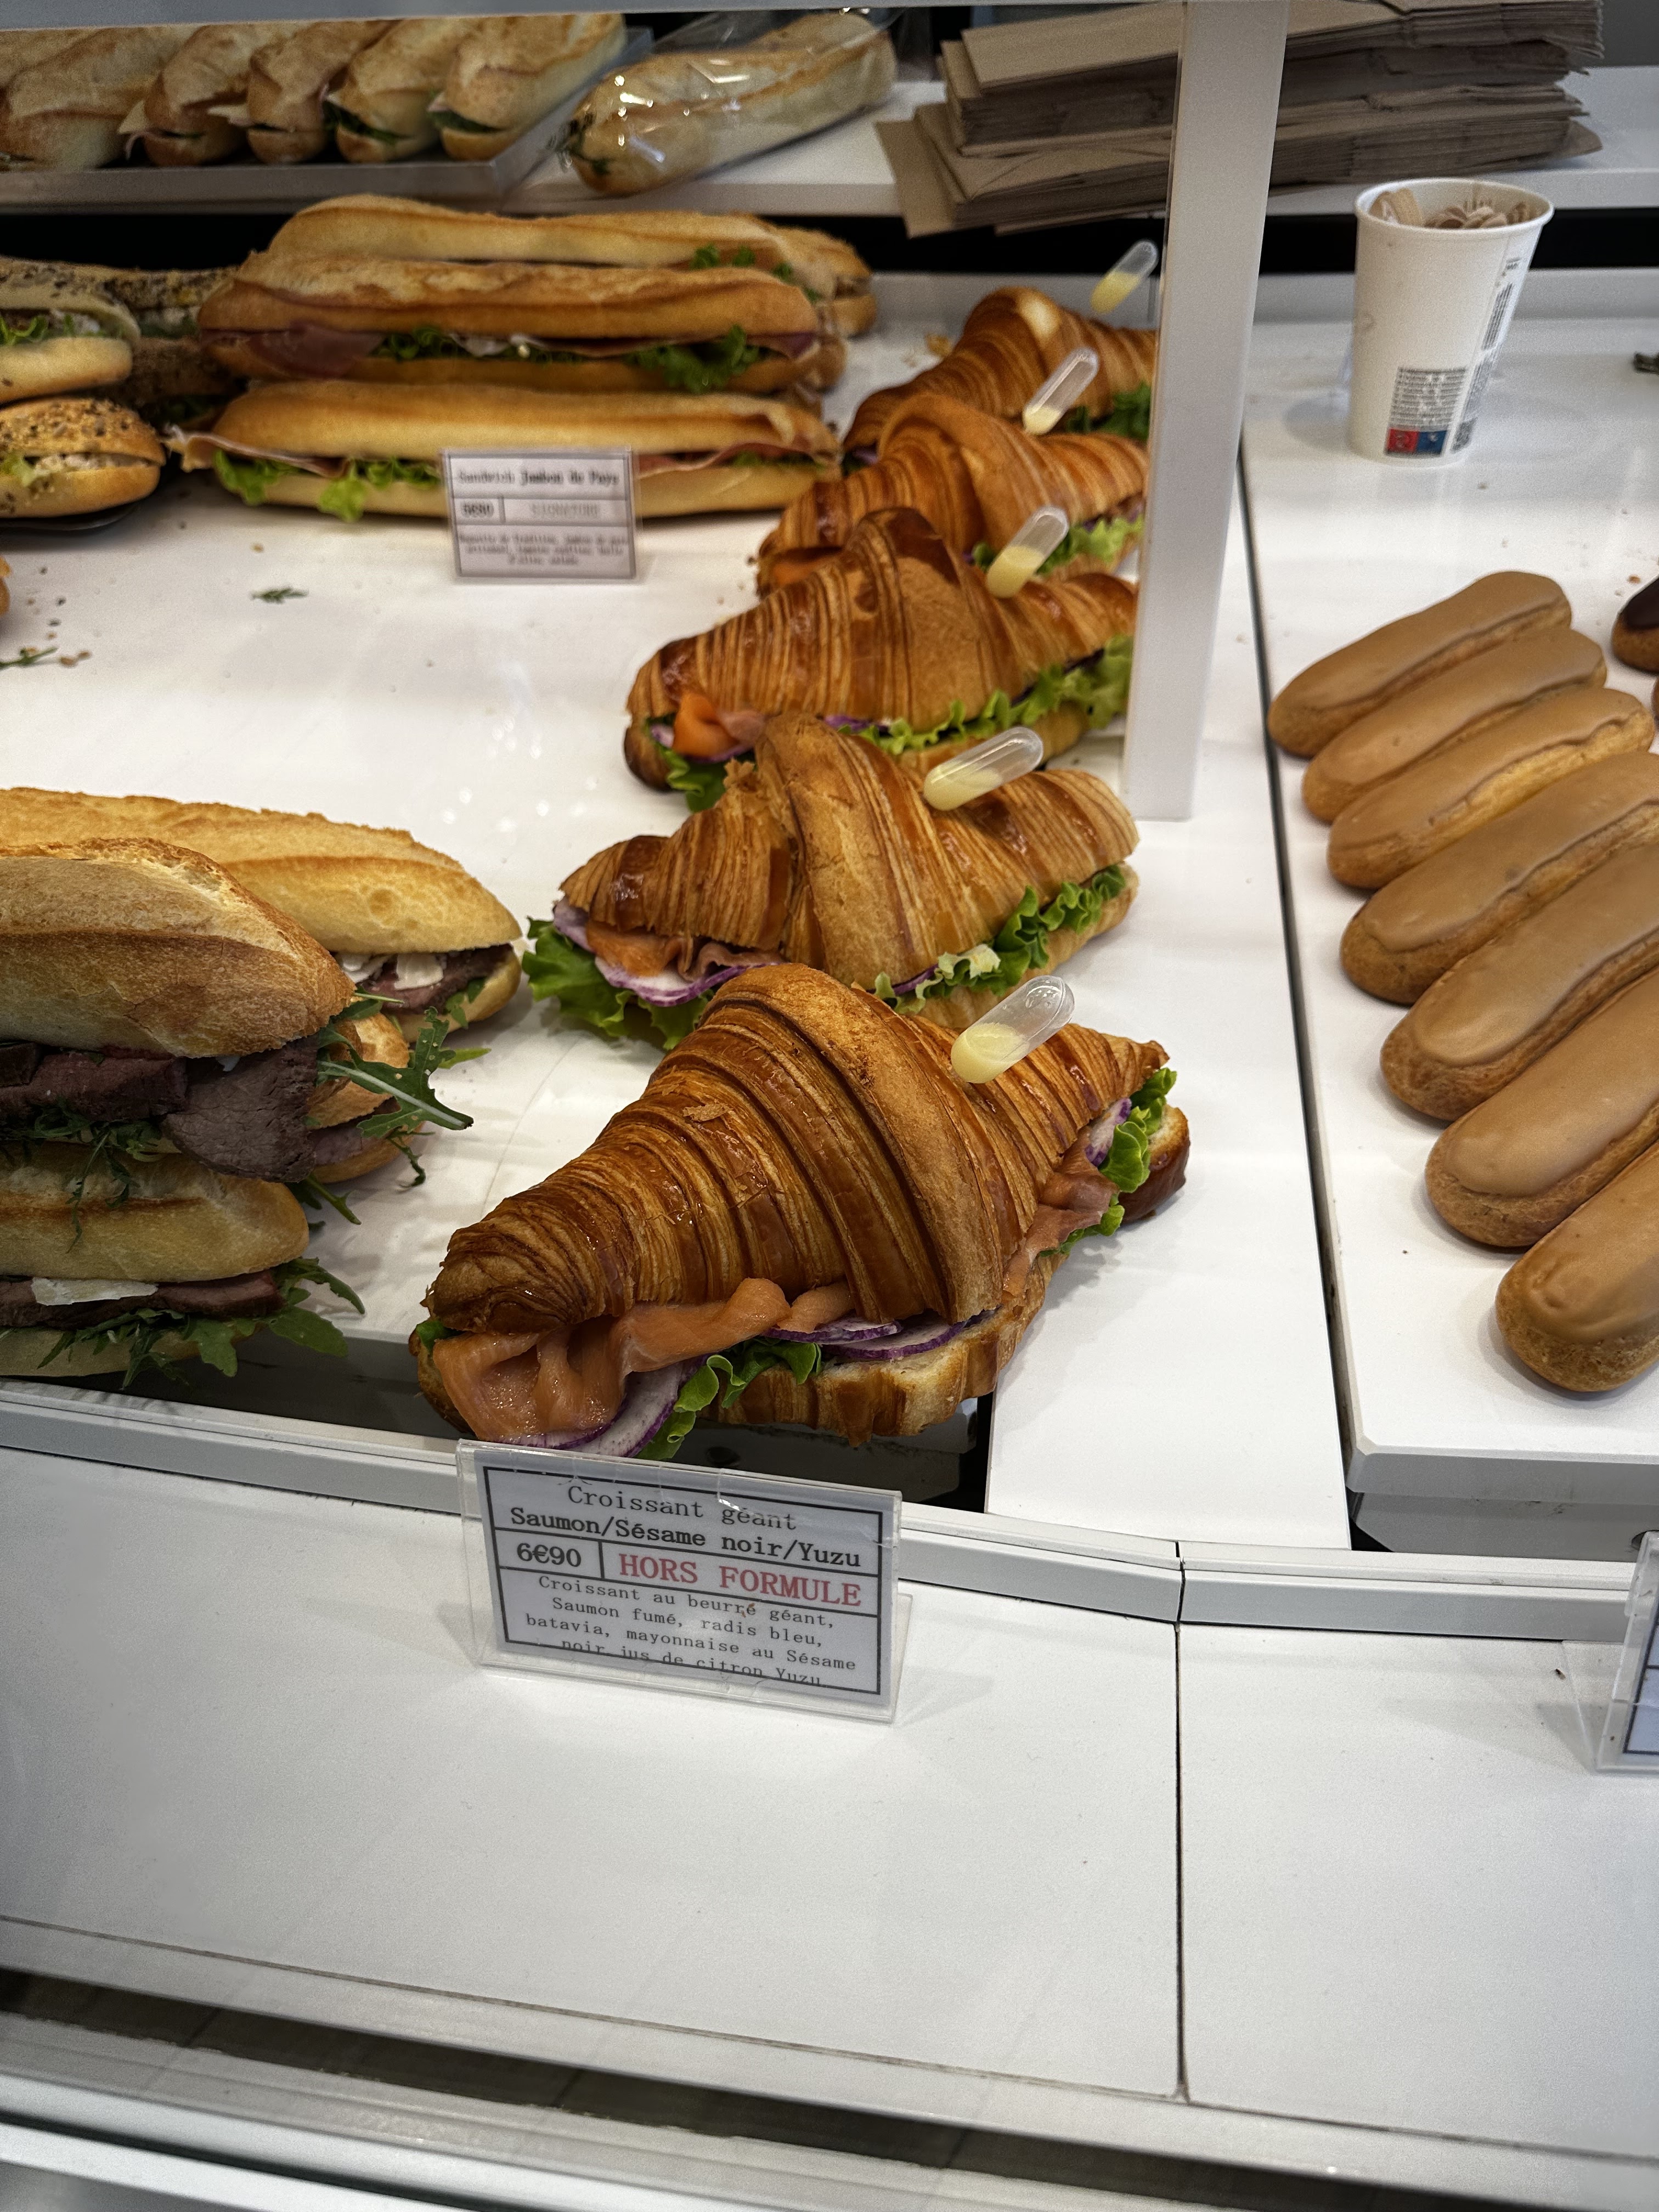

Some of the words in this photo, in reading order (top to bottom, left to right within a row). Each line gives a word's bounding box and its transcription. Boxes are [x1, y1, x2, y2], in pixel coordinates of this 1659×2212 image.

[568, 1486, 703, 1517] Croissant
[721, 1508, 796, 1530] géant
[510, 1507, 706, 1546] Saumon/Sésame
[721, 1537, 861, 1567] noir/Yuzu
[517, 1543, 582, 1567] 6€90
[539, 1576, 640, 1600] Croissant
[653, 1594, 675, 1605] au
[770, 1609, 834, 1629] géant,
[618, 1553, 698, 1584] HORS
[719, 1565, 861, 1607] FORMULE
[526, 1613, 610, 1638] batavia,
[626, 1630, 740, 1654] mayonnaise
[752, 1648, 774, 1659] au
[786, 1650, 856, 1670] Sésame
[552, 1598, 619, 1618] Saumon
[633, 1608, 683, 1628] fumé,
[701, 1620, 757, 1636] radis
[770, 1627, 822, 1647] bleu,
[662, 1652, 684, 1665] de
[697, 1657, 763, 1677] citron
[776, 1667, 821, 1685] Yuzu
